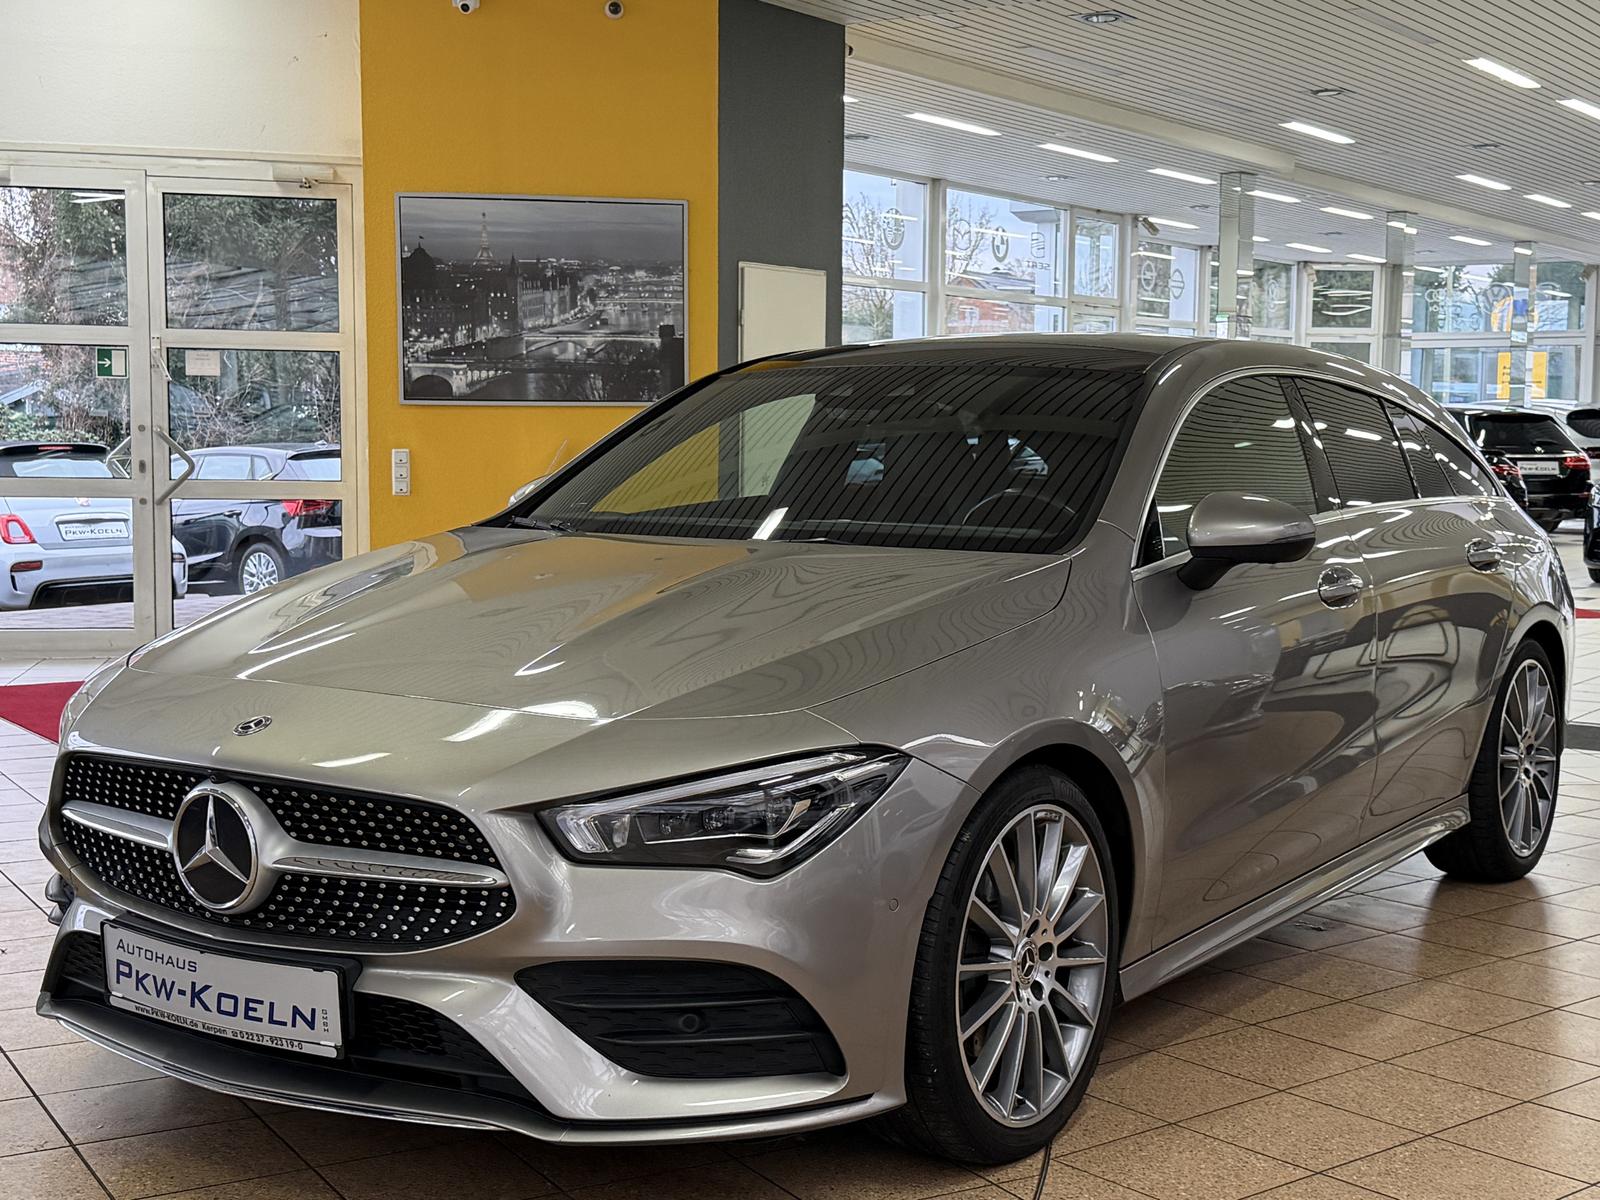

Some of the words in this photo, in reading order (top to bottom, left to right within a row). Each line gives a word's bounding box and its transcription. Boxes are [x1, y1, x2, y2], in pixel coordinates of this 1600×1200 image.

[65, 528, 122, 536] PKW-KOELN
[116, 938, 197, 973] AUTOHAUS
[115, 959, 316, 1031] PKW-KOELN
[201, 1023, 228, 1036] Kerpen
